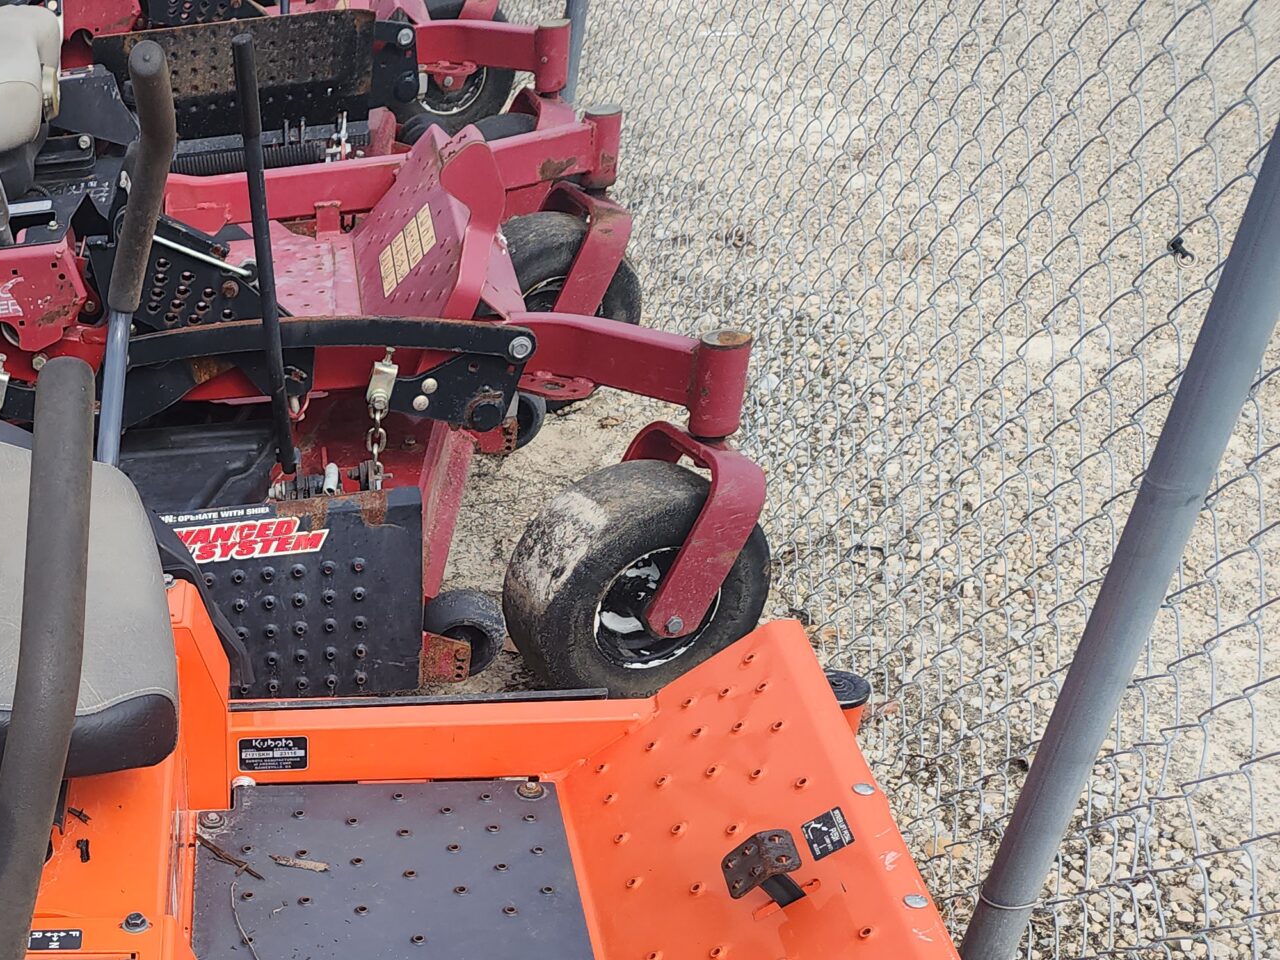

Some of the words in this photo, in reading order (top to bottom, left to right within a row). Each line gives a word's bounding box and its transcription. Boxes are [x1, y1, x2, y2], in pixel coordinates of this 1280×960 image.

[177, 511, 219, 522] OPERATE
[220, 508, 245, 517] WITH
[195, 531, 325, 561] SYSTEM
[252, 738, 294, 748] Kubota
